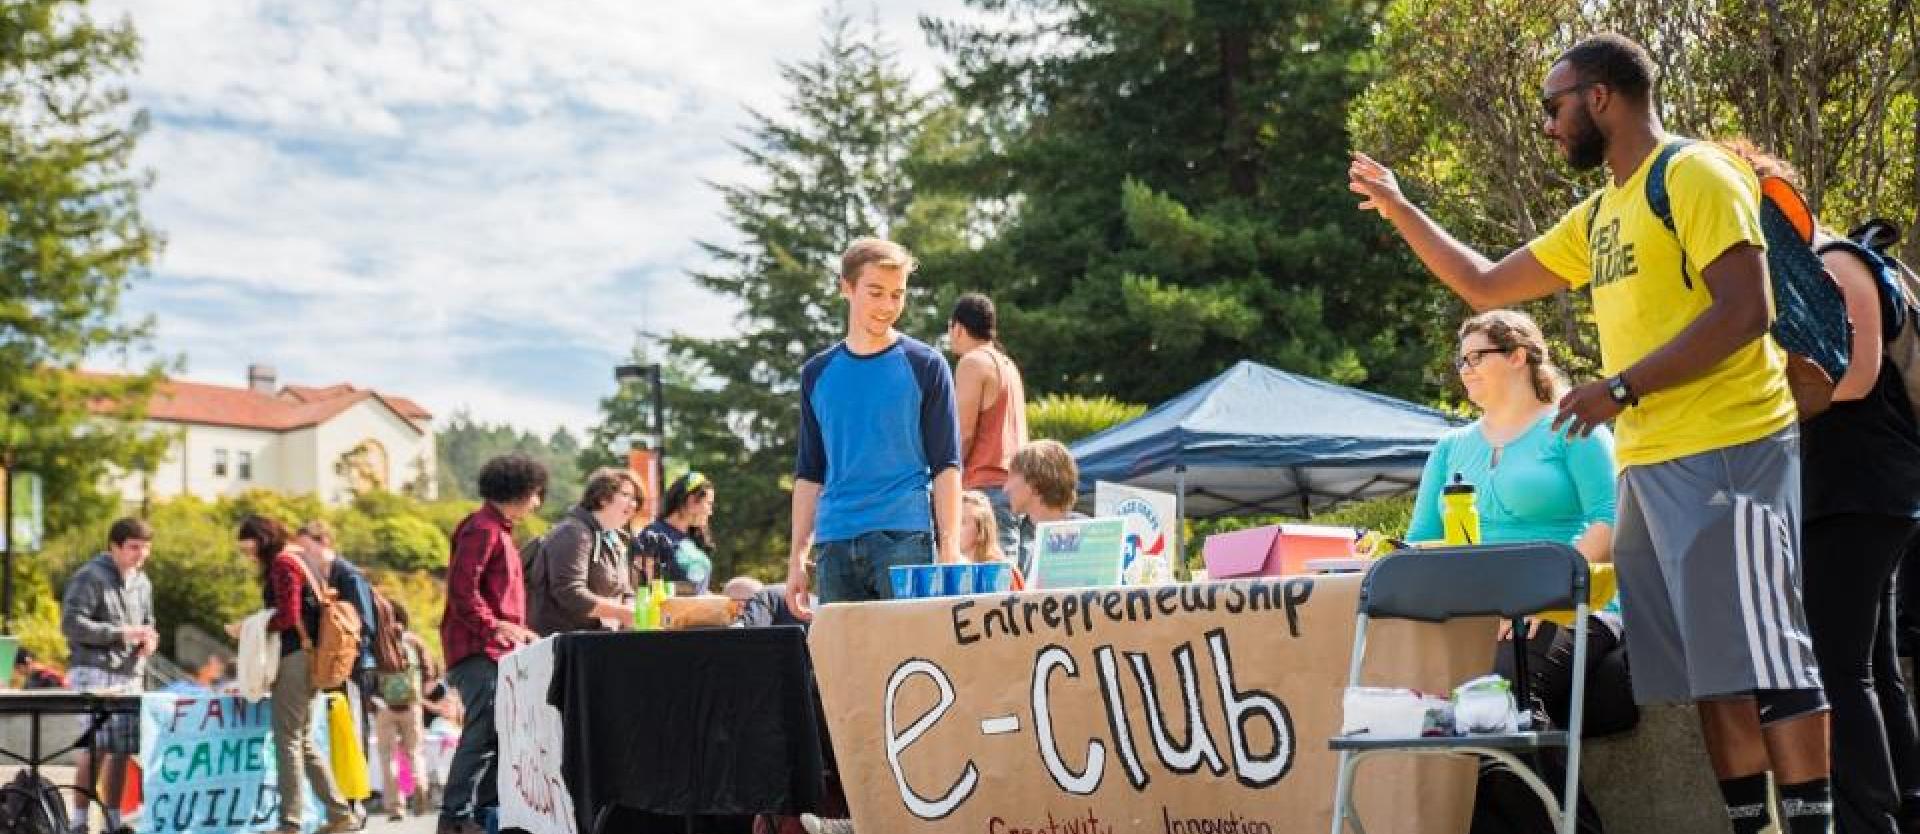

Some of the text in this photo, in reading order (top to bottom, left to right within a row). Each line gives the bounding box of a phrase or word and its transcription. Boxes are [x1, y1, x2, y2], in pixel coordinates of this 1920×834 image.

[952, 579, 1315, 645] Entrepreneurship
[885, 628, 1296, 820] e-Club
[151, 784, 280, 832] GUILD
